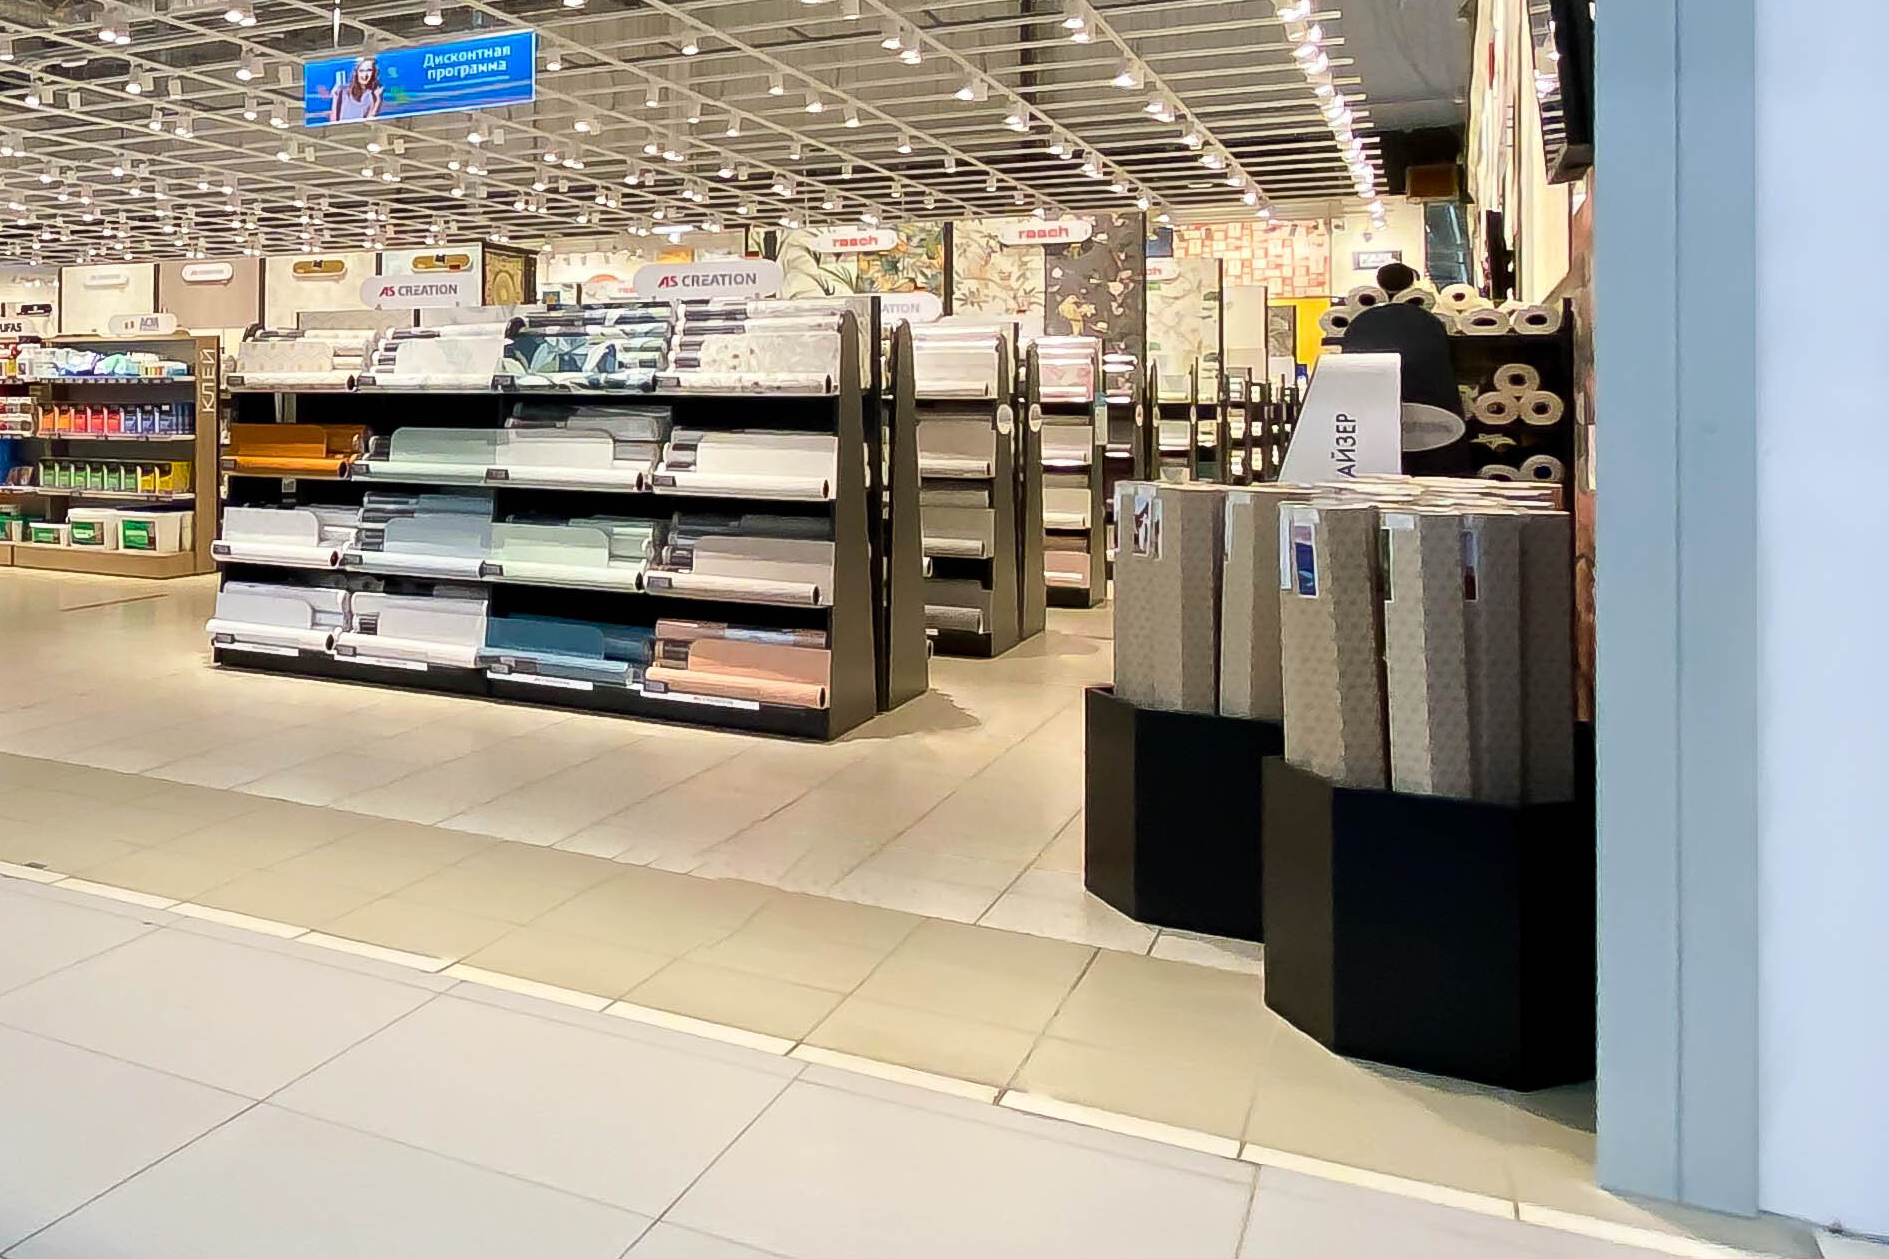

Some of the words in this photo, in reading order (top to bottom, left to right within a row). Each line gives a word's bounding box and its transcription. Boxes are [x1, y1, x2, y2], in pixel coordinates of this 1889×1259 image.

[423, 45, 511, 69] Дисконтная
[427, 60, 507, 82] программа
[657, 275, 679, 288] AS
[681, 273, 757, 288] CREATION
[378, 285, 396, 298] AS
[397, 284, 458, 296] CREATION
[882, 302, 920, 315] ATION
[201, 348, 215, 412] КЛЕЙ
